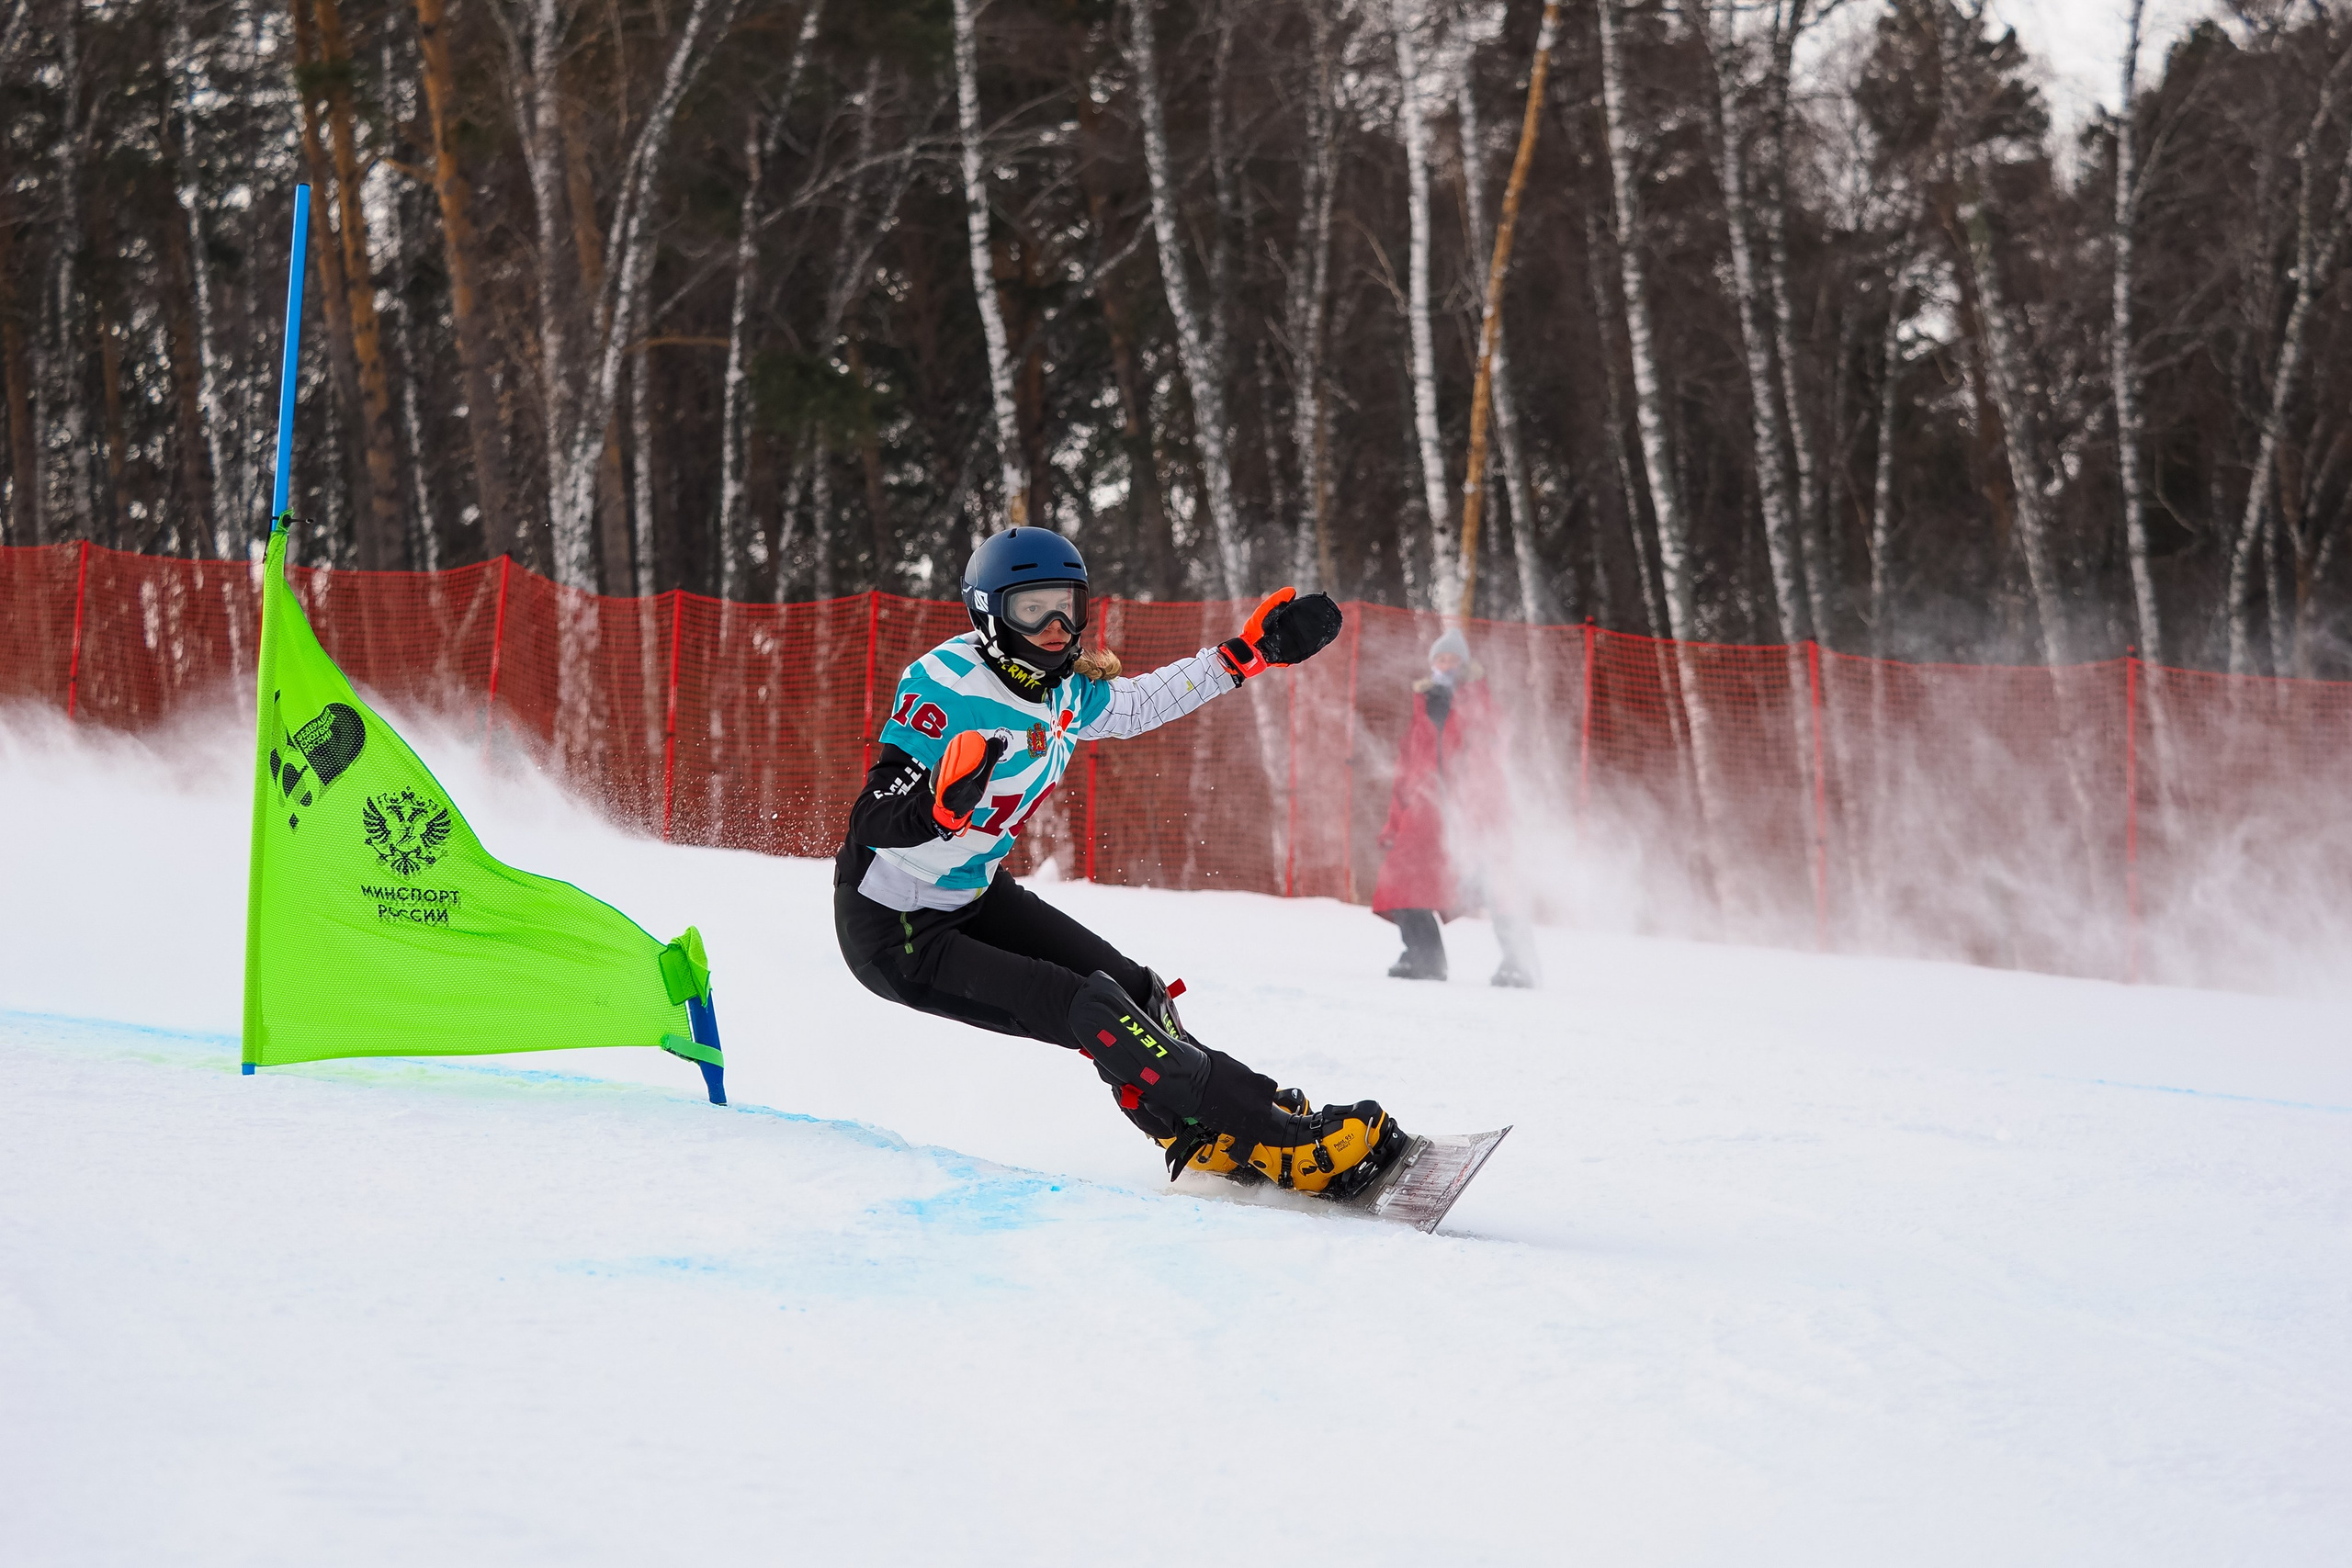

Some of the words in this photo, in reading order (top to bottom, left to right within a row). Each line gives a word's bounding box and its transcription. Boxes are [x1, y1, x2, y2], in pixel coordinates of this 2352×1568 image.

[892, 694, 948, 739] 16
[361, 885, 459, 903] МИНСПОРТ
[378, 904, 448, 922] РОССИИ
[1119, 1014, 1168, 1058] LEKI
